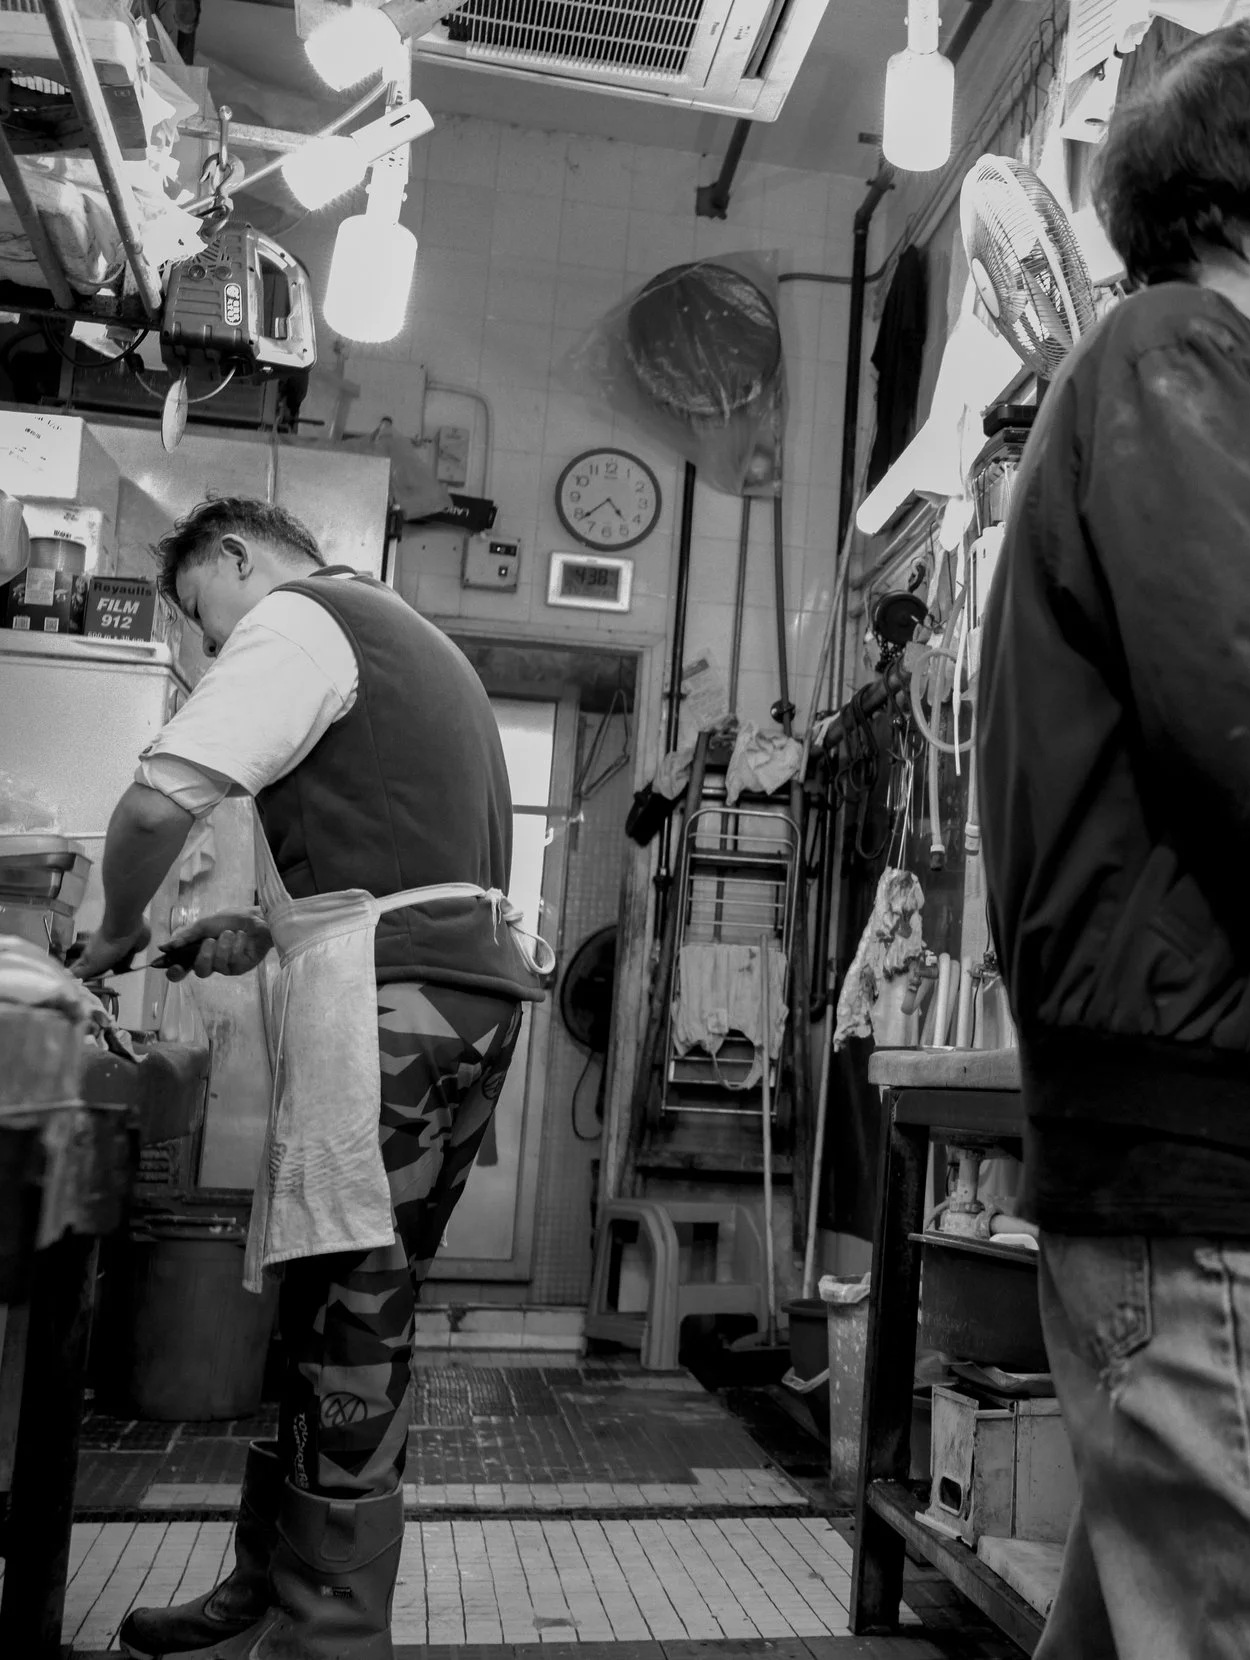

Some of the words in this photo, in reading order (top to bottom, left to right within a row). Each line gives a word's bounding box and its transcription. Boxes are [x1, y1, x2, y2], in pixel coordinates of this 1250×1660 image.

[589, 464, 598, 475] 11
[605, 460, 618, 474] 12
[575, 475, 589, 487] 10
[635, 481, 645, 493] 2
[570, 491, 580, 502] 9
[639, 499, 648, 510] 3
[573, 508, 585, 520] 8
[632, 514, 641, 525] 4
[588, 521, 597, 533] 7
[602, 526, 612, 538] 6
[619, 524, 629, 537] 5
[96, 597, 141, 615] FILM
[100, 613, 133, 630] 912
